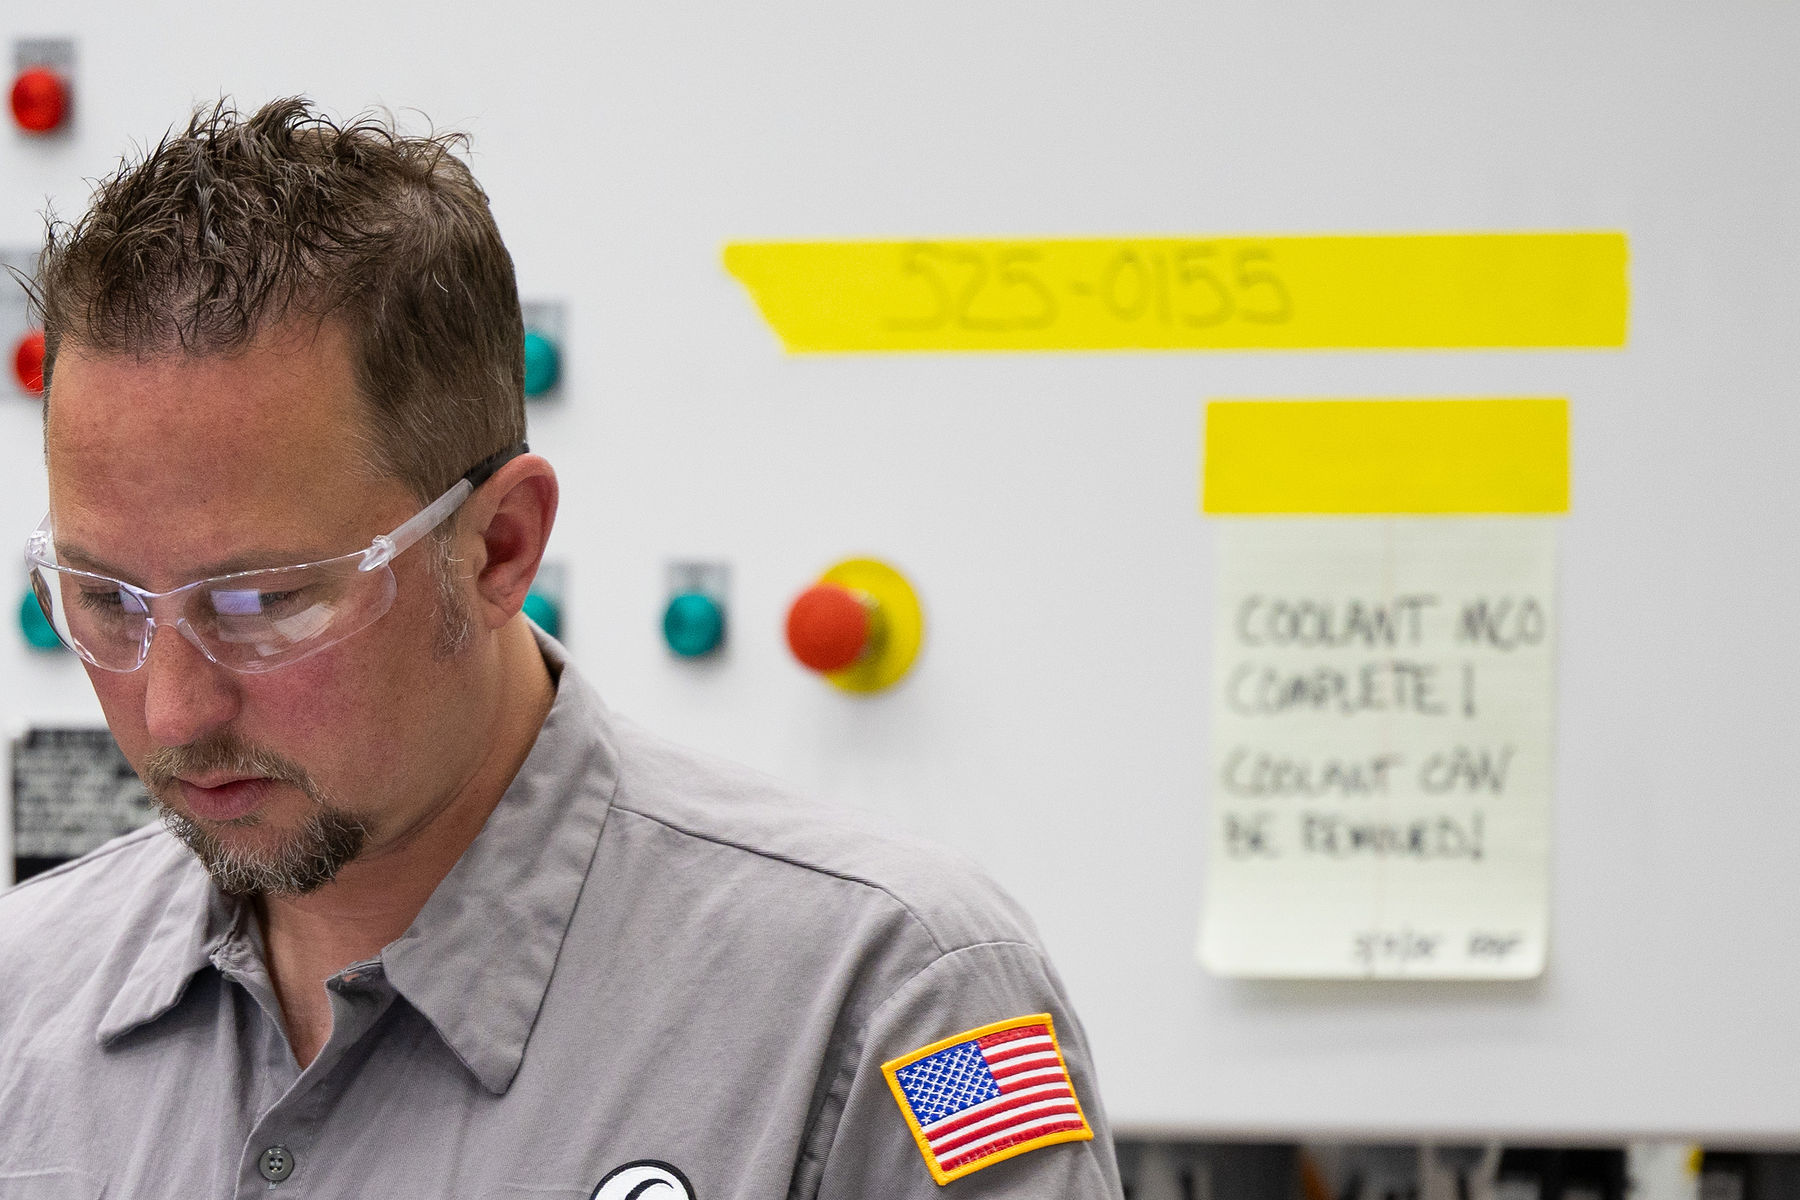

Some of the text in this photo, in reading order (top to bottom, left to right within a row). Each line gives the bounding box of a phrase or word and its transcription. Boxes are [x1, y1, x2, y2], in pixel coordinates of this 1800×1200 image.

[881, 239, 1294, 332] 525-0155
[1235, 591, 1432, 650] COOLANT
[1419, 746, 1515, 796] CAN
